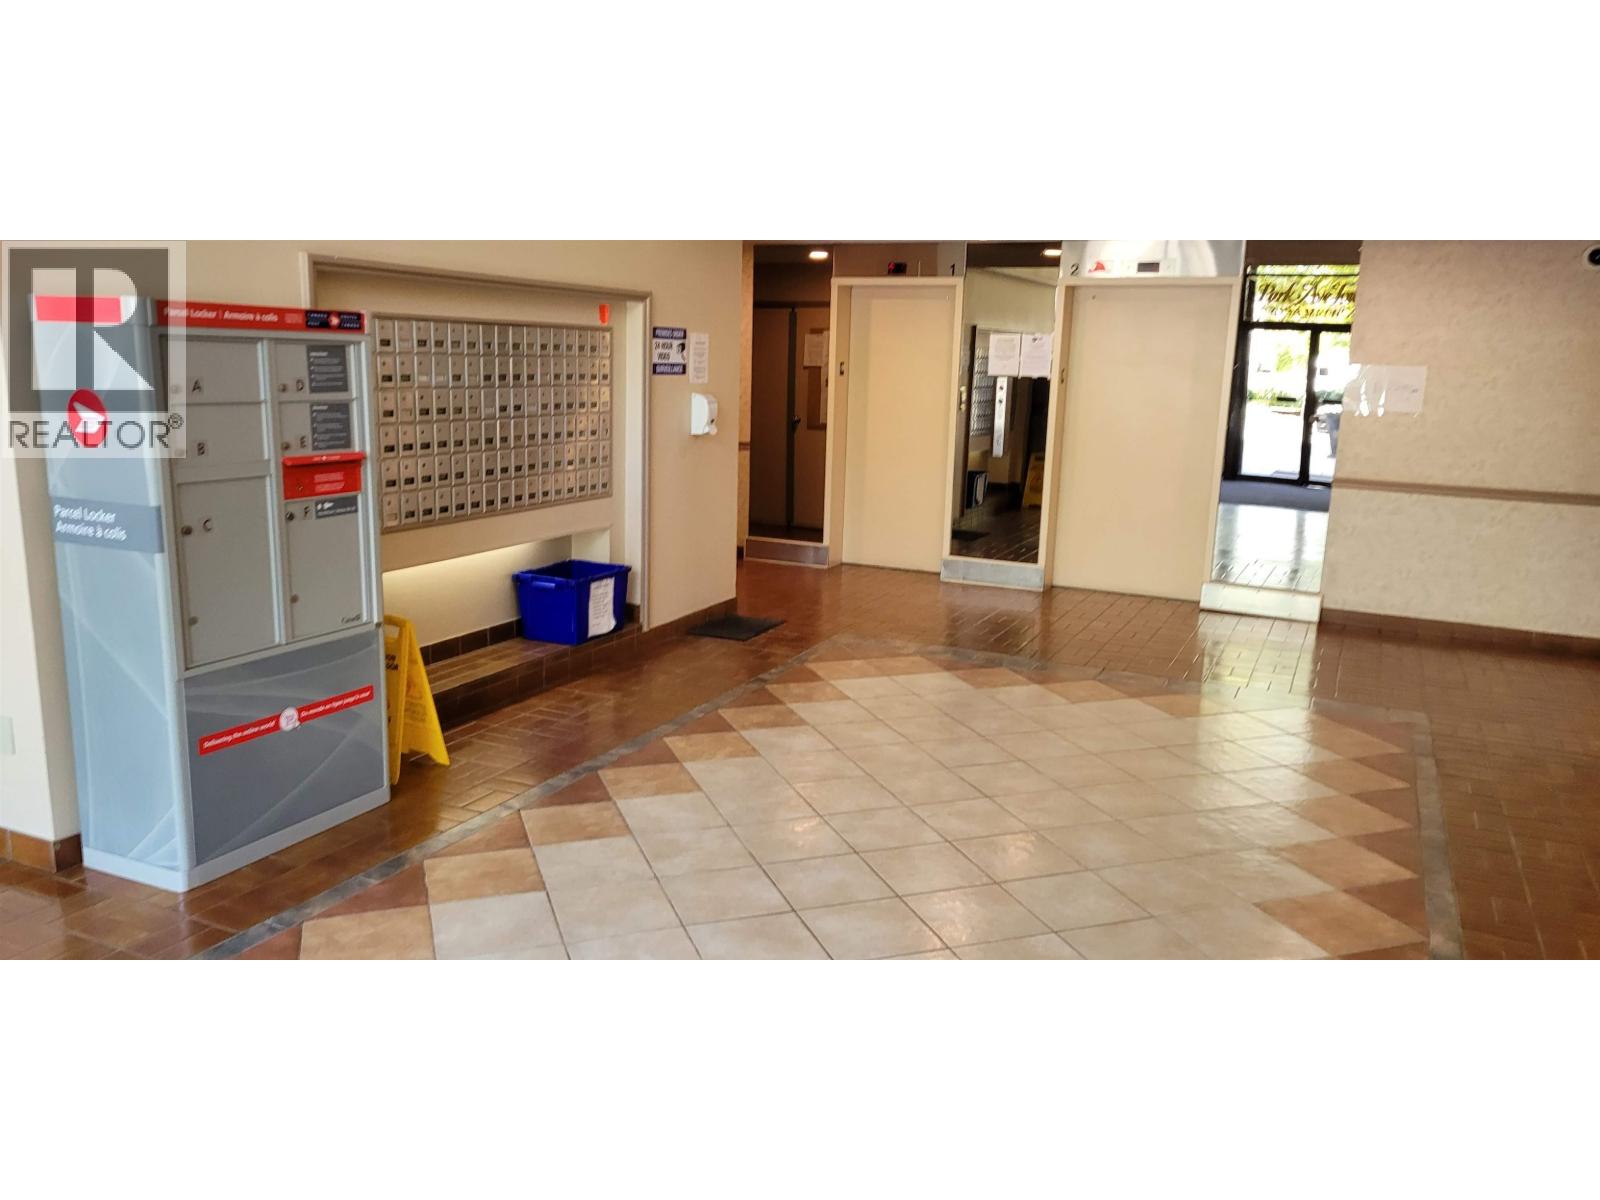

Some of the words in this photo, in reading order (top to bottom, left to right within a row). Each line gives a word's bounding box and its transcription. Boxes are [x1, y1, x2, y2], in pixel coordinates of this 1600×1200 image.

[950, 263, 956, 276] 1
[1070, 263, 1080, 276] 2
[190, 309, 217, 319] Locker
[223, 311, 254, 321] Armoire
[261, 313, 278, 322] colis
[192, 380, 202, 392] A
[296, 379, 304, 392] D
[197, 442, 206, 456] B
[53, 504, 82, 520] Parcel
[83, 507, 116, 524] Locker
[55, 519, 95, 537] Armoire
[103, 526, 128, 541] colis
[202, 518, 213, 532] C
